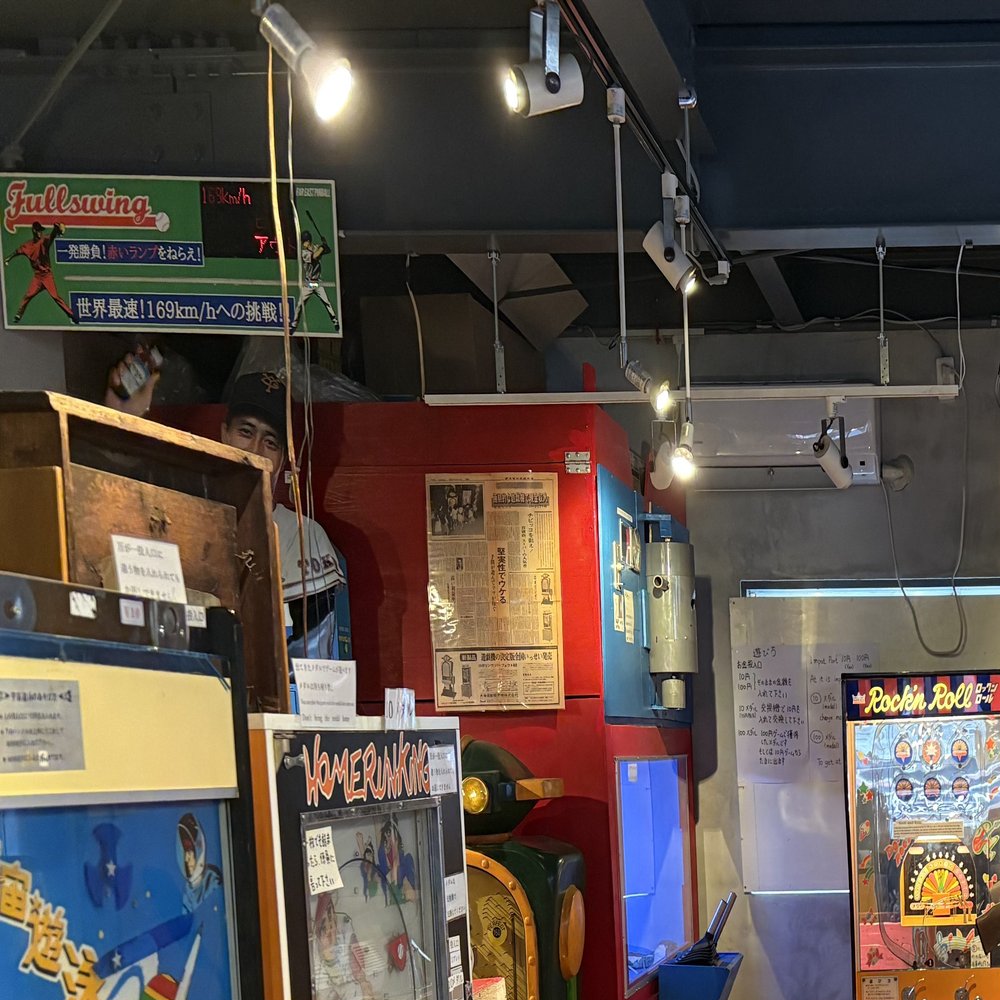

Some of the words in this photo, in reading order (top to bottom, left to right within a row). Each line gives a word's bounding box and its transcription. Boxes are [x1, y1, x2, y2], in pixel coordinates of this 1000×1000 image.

[5, 180, 151, 224] Fullswing
[864, 684, 926, 714] Rock'n
[928, 682, 973, 712] Roll
[975, 683, 999, 694] ロックン
[975, 693, 994, 705] ロール
